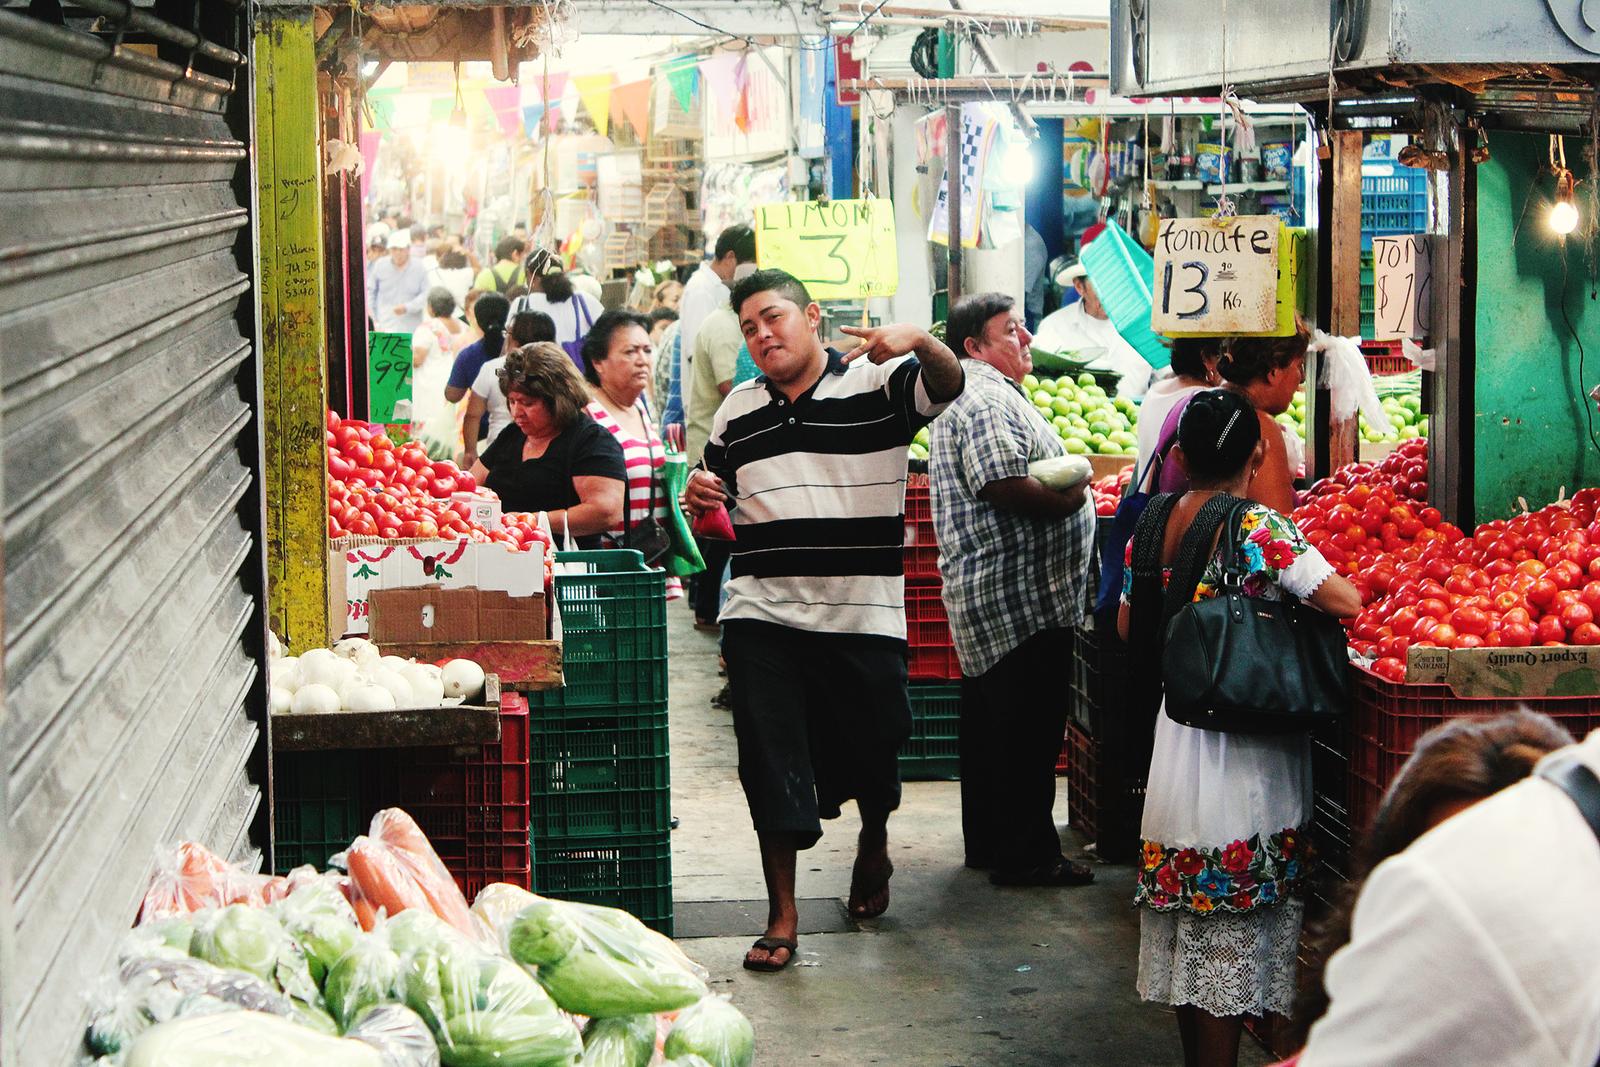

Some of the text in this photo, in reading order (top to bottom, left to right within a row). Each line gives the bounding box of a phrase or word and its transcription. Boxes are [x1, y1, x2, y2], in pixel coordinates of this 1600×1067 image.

[762, 203, 870, 230] LIMON
[1160, 220, 1271, 254] tomate
[800, 234, 850, 285] 3
[1162, 260, 1209, 319] 13
[375, 360, 411, 392] 99
[1486, 649, 1588, 667] Export Quality
